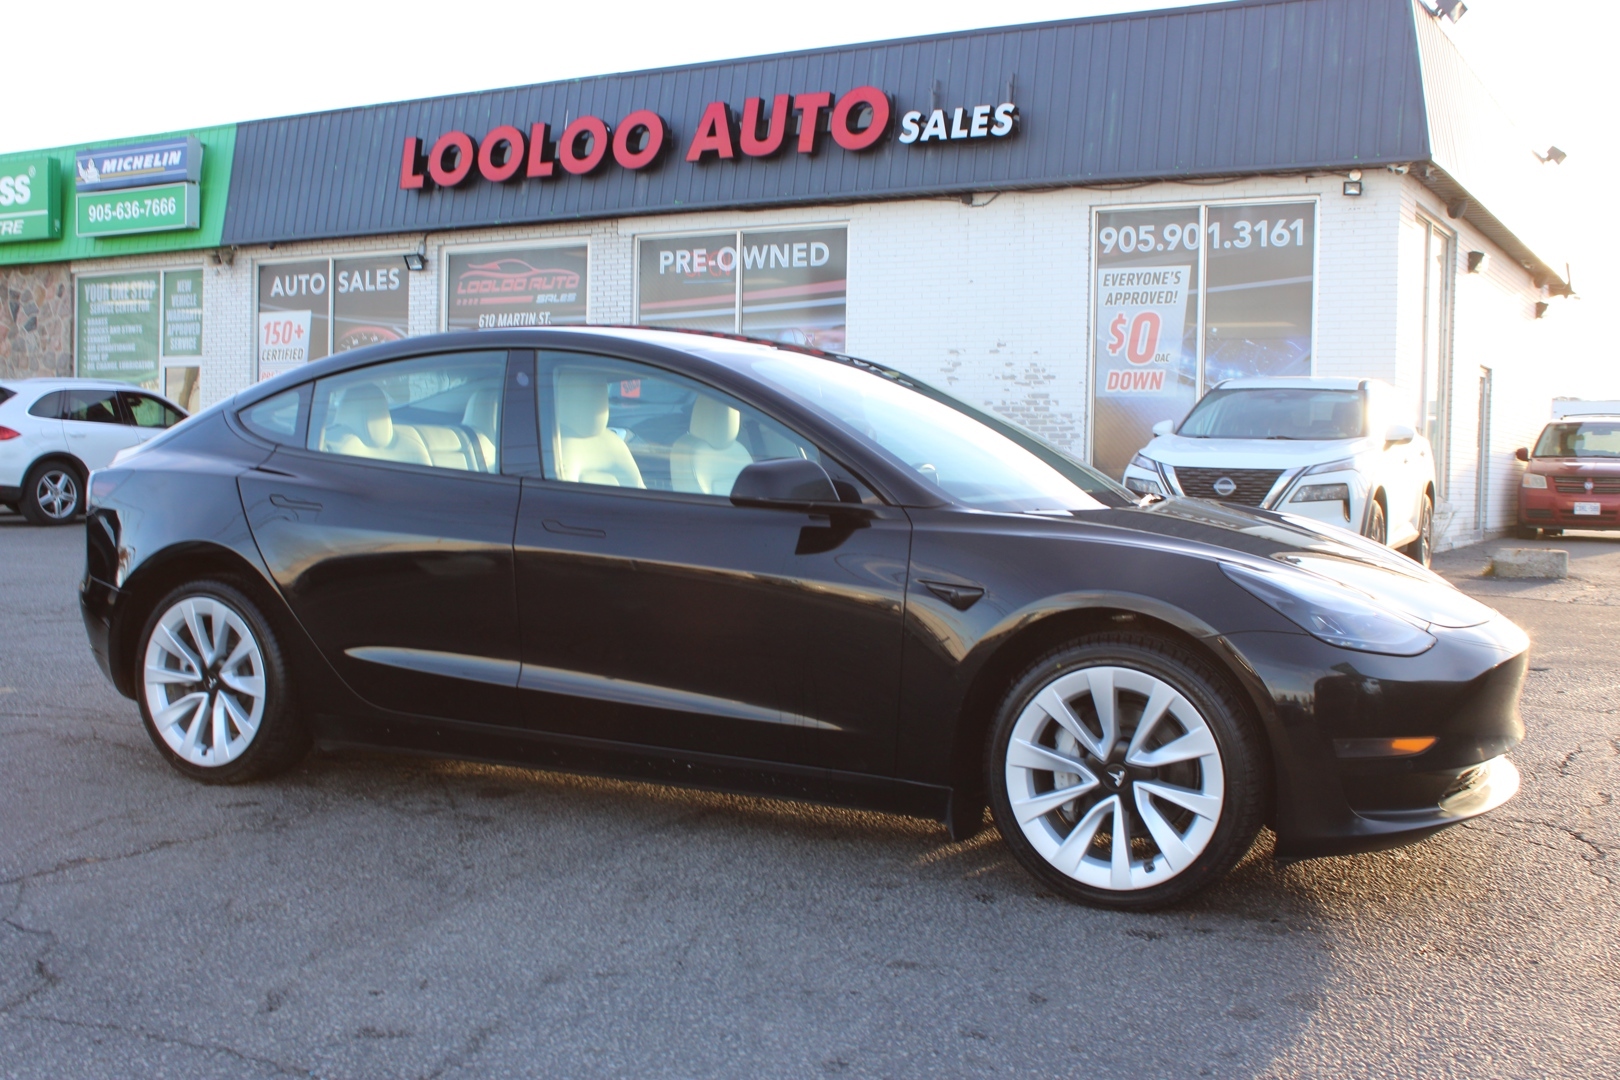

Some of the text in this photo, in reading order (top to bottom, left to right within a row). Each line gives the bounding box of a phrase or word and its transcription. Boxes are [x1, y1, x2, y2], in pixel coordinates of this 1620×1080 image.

[399, 85, 1016, 190] LOOLOO AUTO SALES
[102, 149, 182, 174] MICHELIN
[88, 196, 176, 223] 905-636-7666
[1099, 218, 1304, 254] 905.901.3161
[659, 241, 830, 275] PRE-OWNED
[177, 279, 192, 293] NEW
[270, 267, 400, 298] AUTO SALES
[456, 275, 580, 294] LOOLOO AUTO
[1102, 270, 1181, 288] EVERYONE'S
[84, 280, 156, 303] YOUR ONE STOP
[171, 293, 197, 307] VEHICLE
[536, 293, 577, 304] SALES
[1104, 290, 1178, 306] APPROVED!
[90, 302, 114, 315] SERVICE
[138, 300, 150, 312] FOR
[167, 308, 202, 321] WARRANTY
[478, 311, 552, 328] 610 MARTIN ST.
[167, 322, 200, 336] APPROVED
[262, 319, 304, 346] 150+
[170, 337, 197, 350] SERVICE
[1107, 311, 1162, 366] $0
[261, 347, 304, 362] CERTIFIED
[1154, 353, 1170, 363] OAC
[1106, 370, 1165, 392] DOWN
